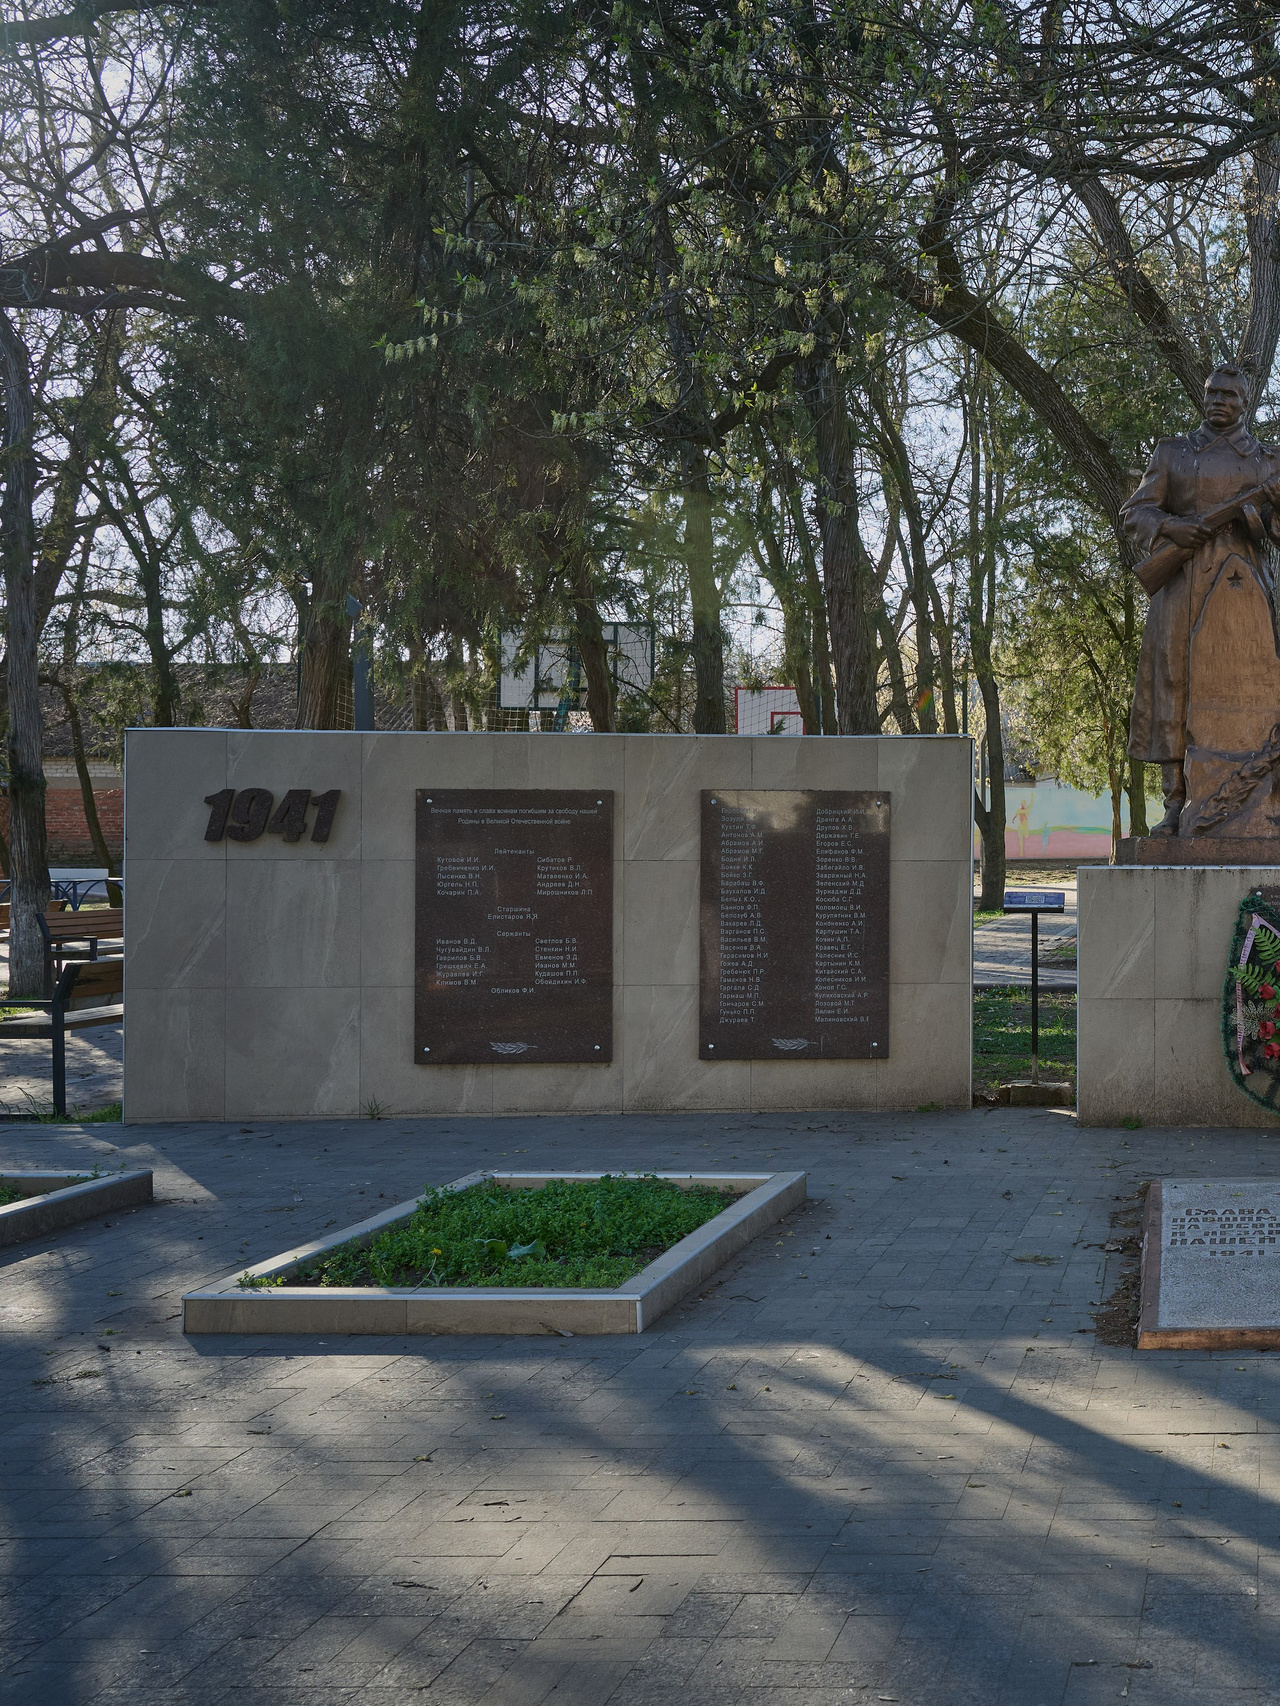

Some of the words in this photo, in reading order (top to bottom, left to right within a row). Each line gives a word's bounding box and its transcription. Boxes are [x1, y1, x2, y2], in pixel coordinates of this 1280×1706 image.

[204, 788, 342, 842] 1941
[1185, 1208, 1271, 1216] СЛАВА
[1170, 1235, 1276, 1245] НАШЕЙ
